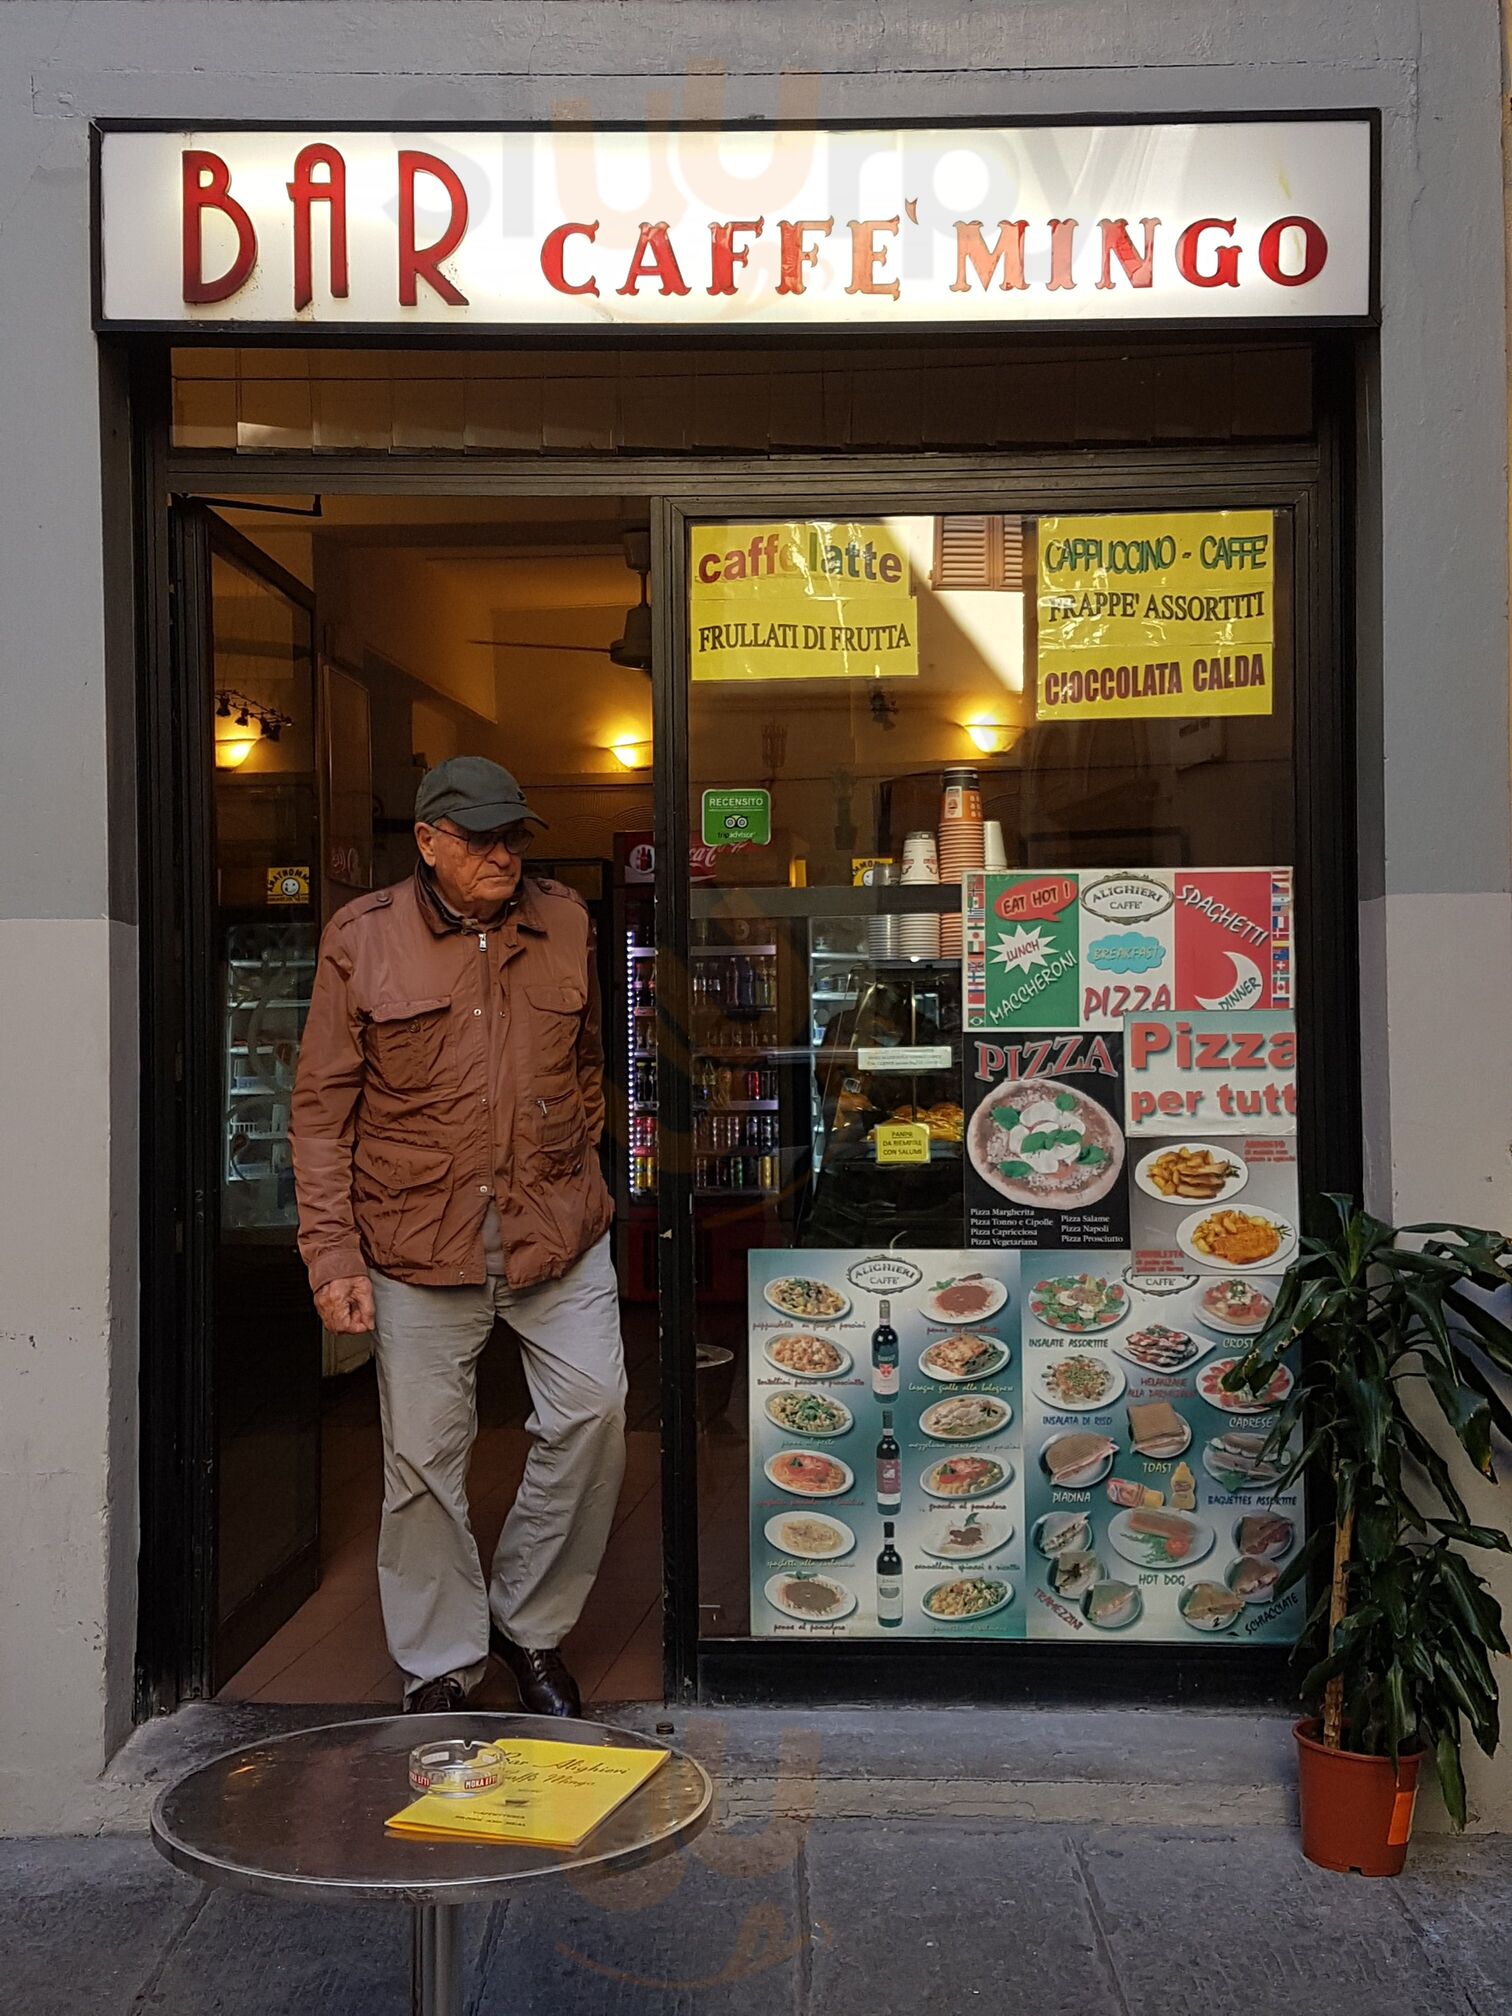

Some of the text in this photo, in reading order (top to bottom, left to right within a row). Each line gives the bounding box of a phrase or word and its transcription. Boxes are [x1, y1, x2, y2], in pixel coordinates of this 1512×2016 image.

[182, 143, 470, 312] BAR
[949, 215, 1329, 293] MINGO
[1045, 535, 1177, 574] CAPPUCCINO
[1144, 591, 1265, 622] ASSORTITI
[699, 622, 911, 652] FRULLATI DI FRUTTA
[1044, 653, 1266, 706] CIOCCOLATA CALDA
[709, 797, 764, 807] RECENSITO
[1002, 897, 1025, 915] EAT
[1033, 888, 1059, 907] HOT
[1092, 887, 1164, 904] ALIGHIERI
[1175, 884, 1270, 947] SPAGHETTI
[1006, 938, 1040, 963] LUNCH
[1093, 944, 1160, 961] BREAKFAST
[989, 950, 1078, 1026] MACCHERONI
[1219, 976, 1262, 1011] DINNER
[1083, 984, 1172, 1022] PIZZA
[1131, 1022, 1296, 1071] Pizza
[974, 1035, 1119, 1083] PIZZA
[1131, 1089, 1203, 1124] per
[970, 1207, 1035, 1219] Pizza Margherita
[1061, 1214, 1110, 1223] Pizza Salame
[970, 1218, 990, 1227] Pizza
[991, 1218, 1017, 1227] Tonno
[1025, 1217, 1053, 1228] Cipolle
[1061, 1224, 1109, 1234] Pizza Napoli
[970, 1227, 1038, 1238] Pizza Capricciosa
[1061, 1234, 1124, 1244] Pizza Prosciutto
[970, 1237, 1038, 1248] Pizza Vegetariana
[855, 1263, 916, 1281] ALIGHIERI
[1028, 1337, 1109, 1348] INSALATE ASSORTITE
[1042, 1416, 1079, 1426] INSALATA
[1082, 1416, 1091, 1425] DI
[1229, 1418, 1273, 1429] CAPRESE
[1142, 1462, 1172, 1473] TOAST
[1052, 1491, 1091, 1503] PIADINA
[1207, 1495, 1252, 1505] BAGUETTES
[1139, 1574, 1186, 1586] HOT DOG
[1032, 1587, 1084, 1631] TRAMEZZINI
[1244, 1592, 1299, 1635] SCHIACCIATE
[465, 1778, 484, 1788] MOKA
